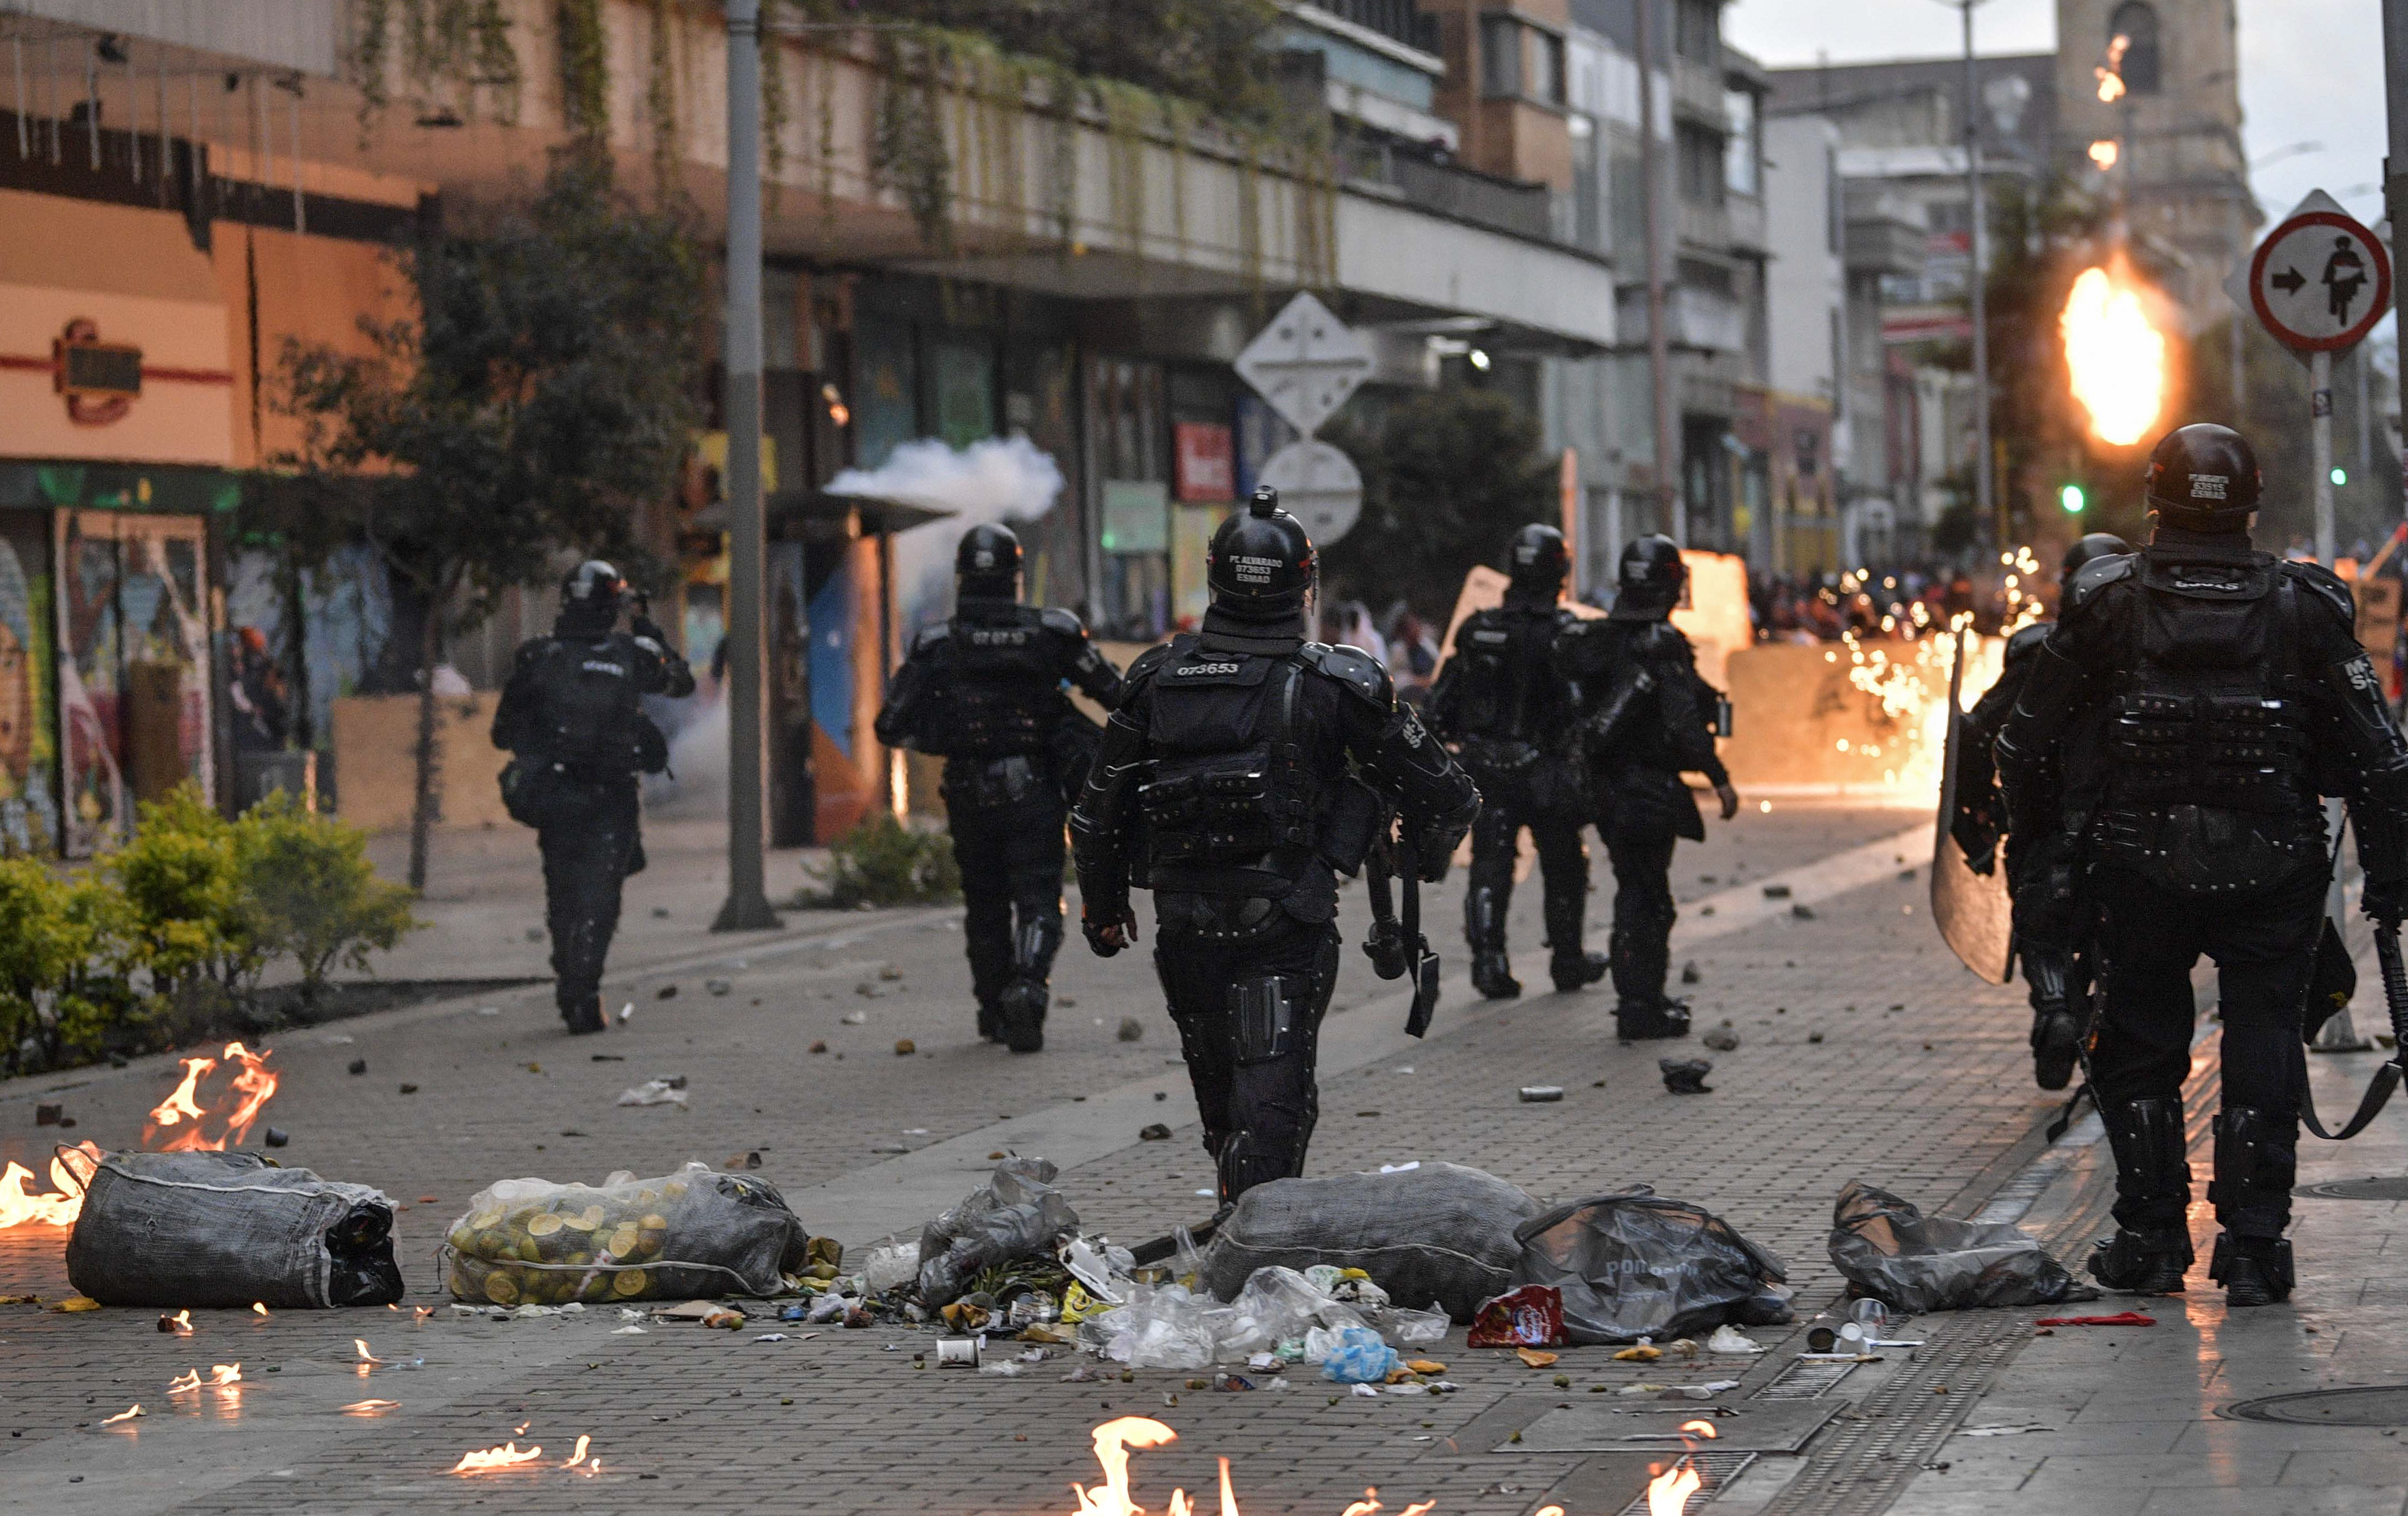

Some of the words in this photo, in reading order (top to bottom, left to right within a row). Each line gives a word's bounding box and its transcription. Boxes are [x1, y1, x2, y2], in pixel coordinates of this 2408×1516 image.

[1236, 564, 1272, 575] 073653
[1237, 573, 1270, 584] ESMAD
[1176, 663, 1239, 676] 073653
